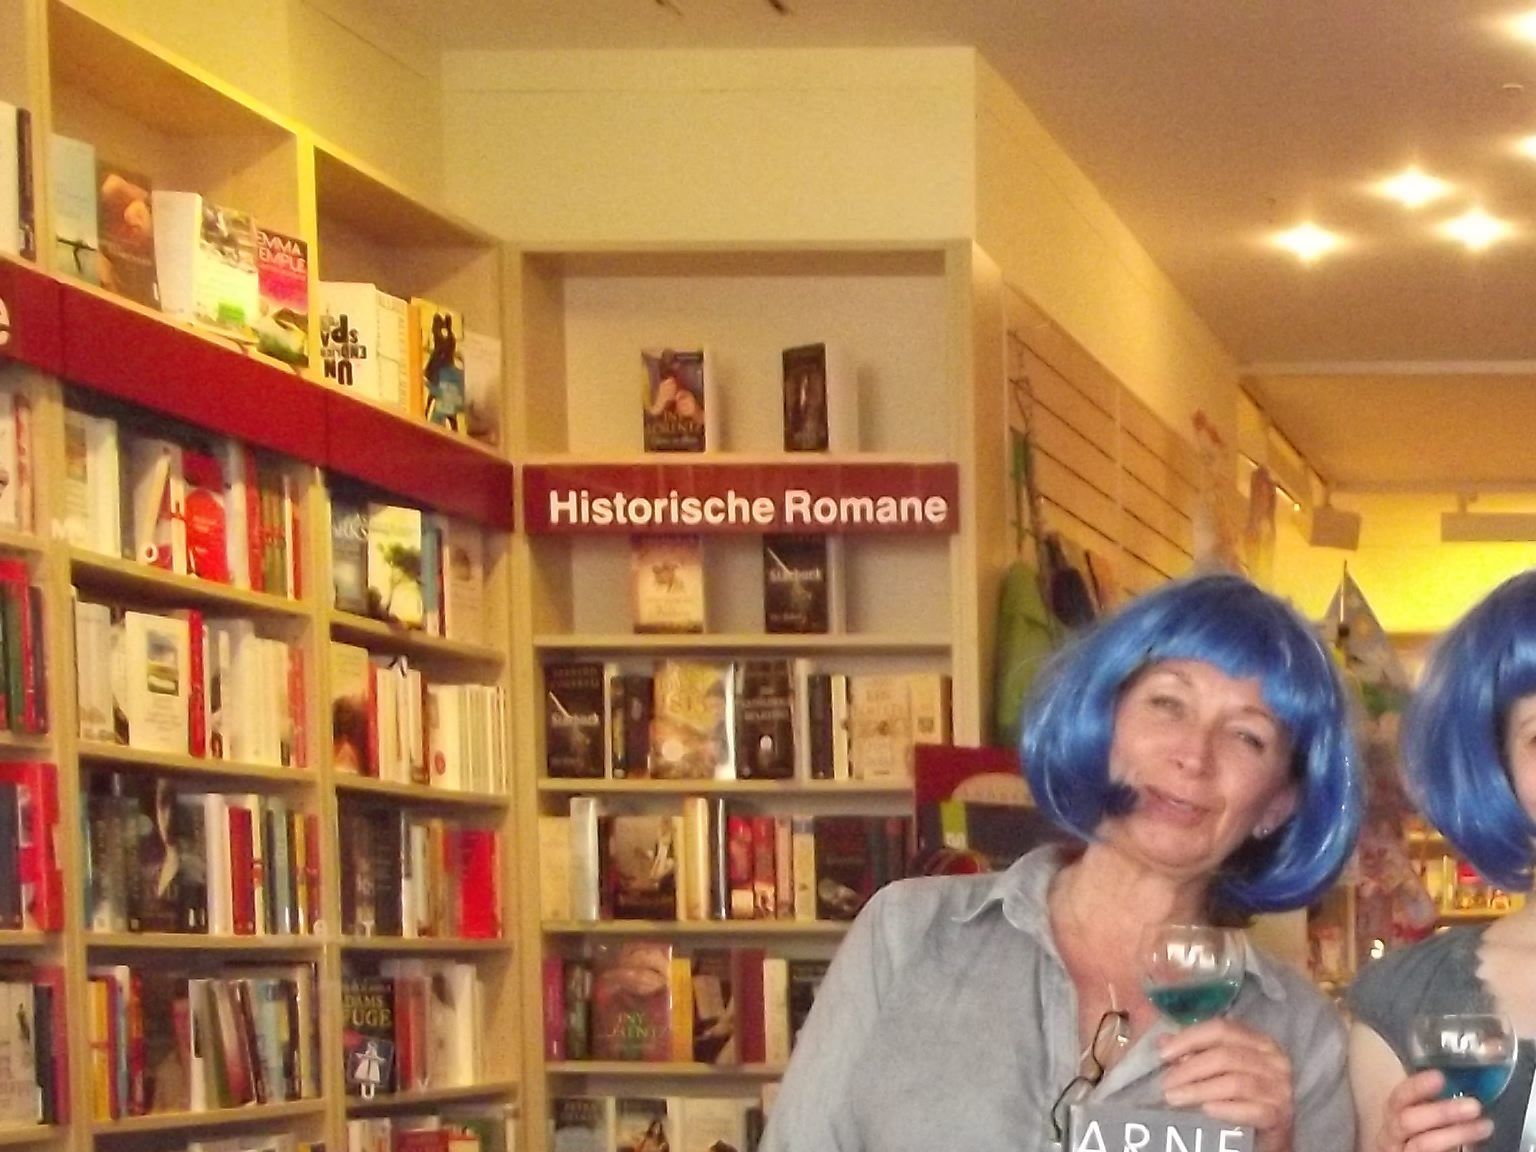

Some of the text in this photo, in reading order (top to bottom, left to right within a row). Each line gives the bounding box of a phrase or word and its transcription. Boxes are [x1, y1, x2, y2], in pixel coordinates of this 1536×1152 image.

[256, 231, 301, 256] EMMA
[258, 248, 306, 273] EMPLE
[549, 489, 948, 524] Historische Romane
